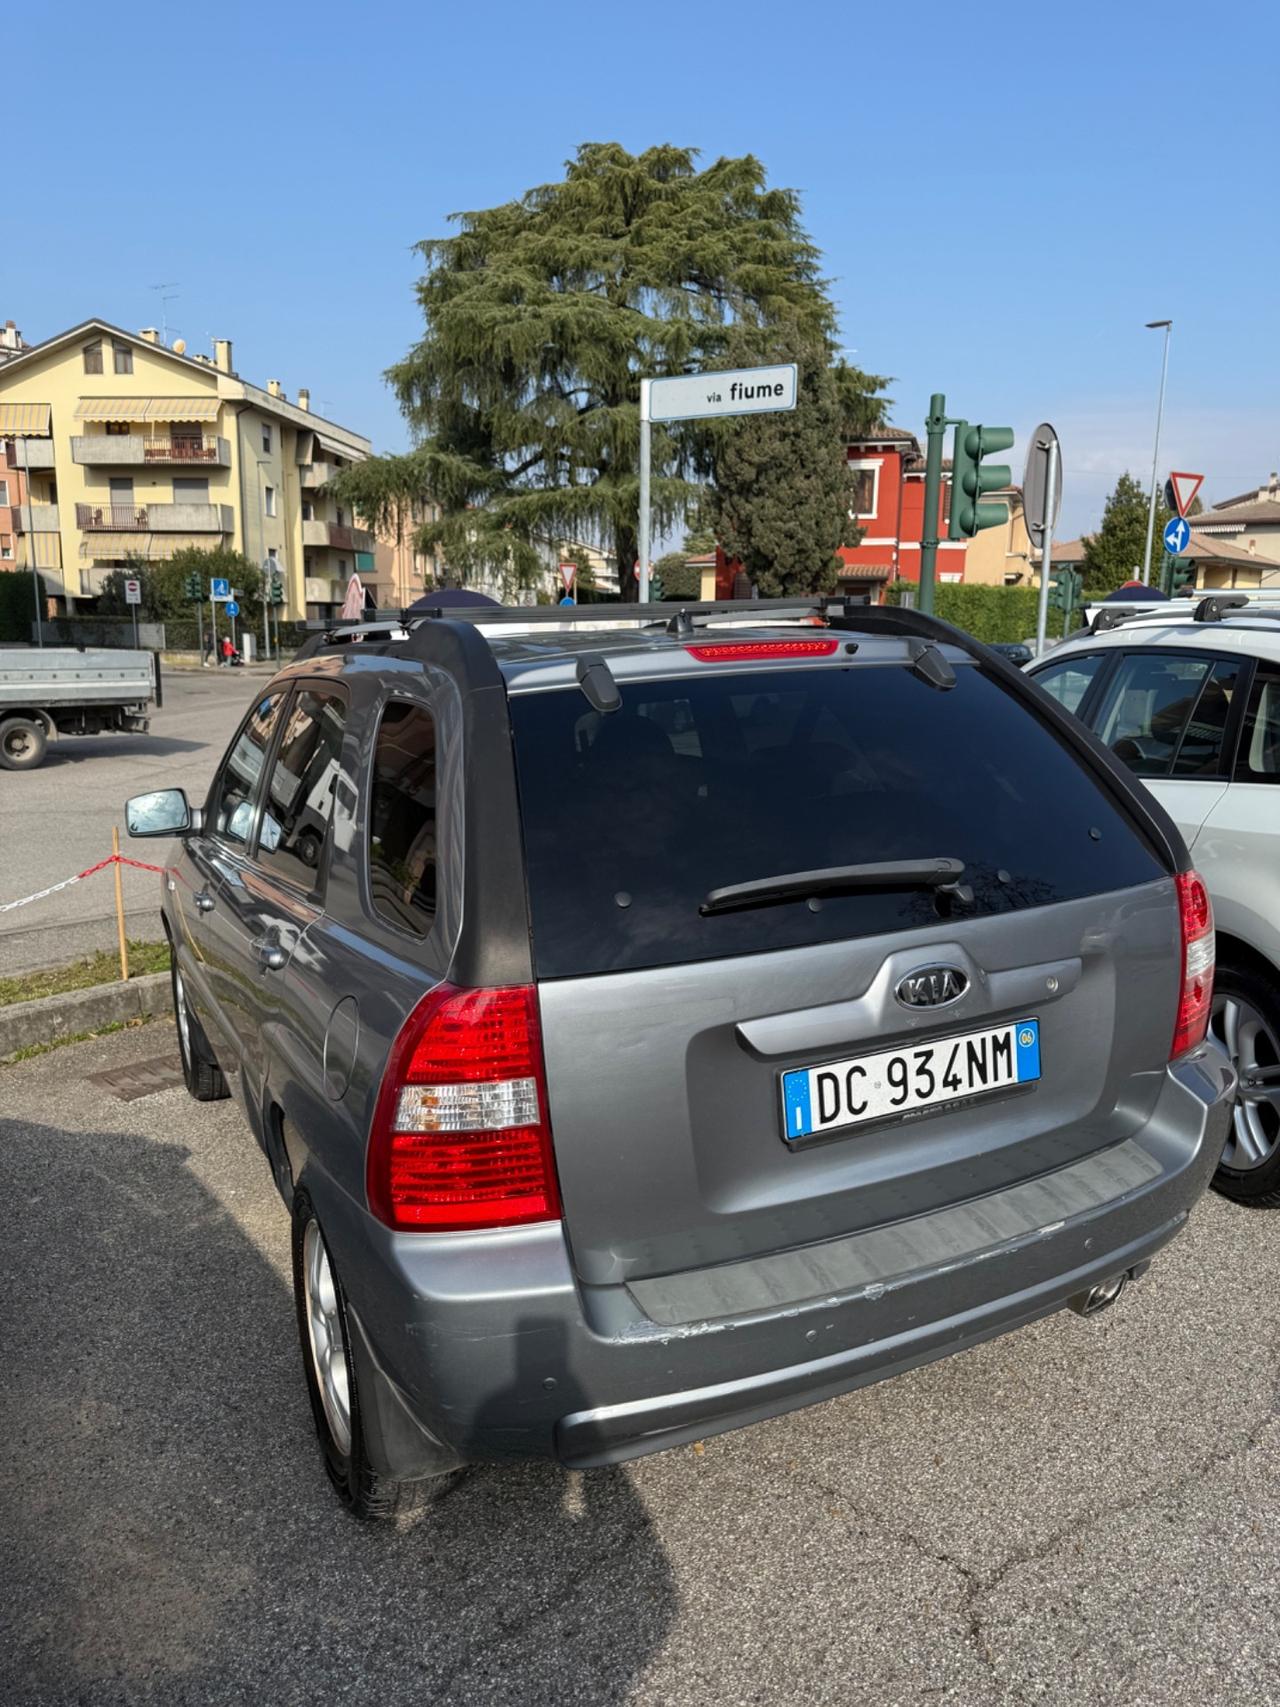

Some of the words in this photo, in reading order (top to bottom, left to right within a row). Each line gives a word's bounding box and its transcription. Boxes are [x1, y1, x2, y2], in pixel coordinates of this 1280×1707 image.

[706, 392, 722, 403] via
[730, 383, 784, 401] fiume
[902, 970, 961, 1002] KIA
[816, 1065, 868, 1124] DC
[887, 1031, 1013, 1106] 934NM
